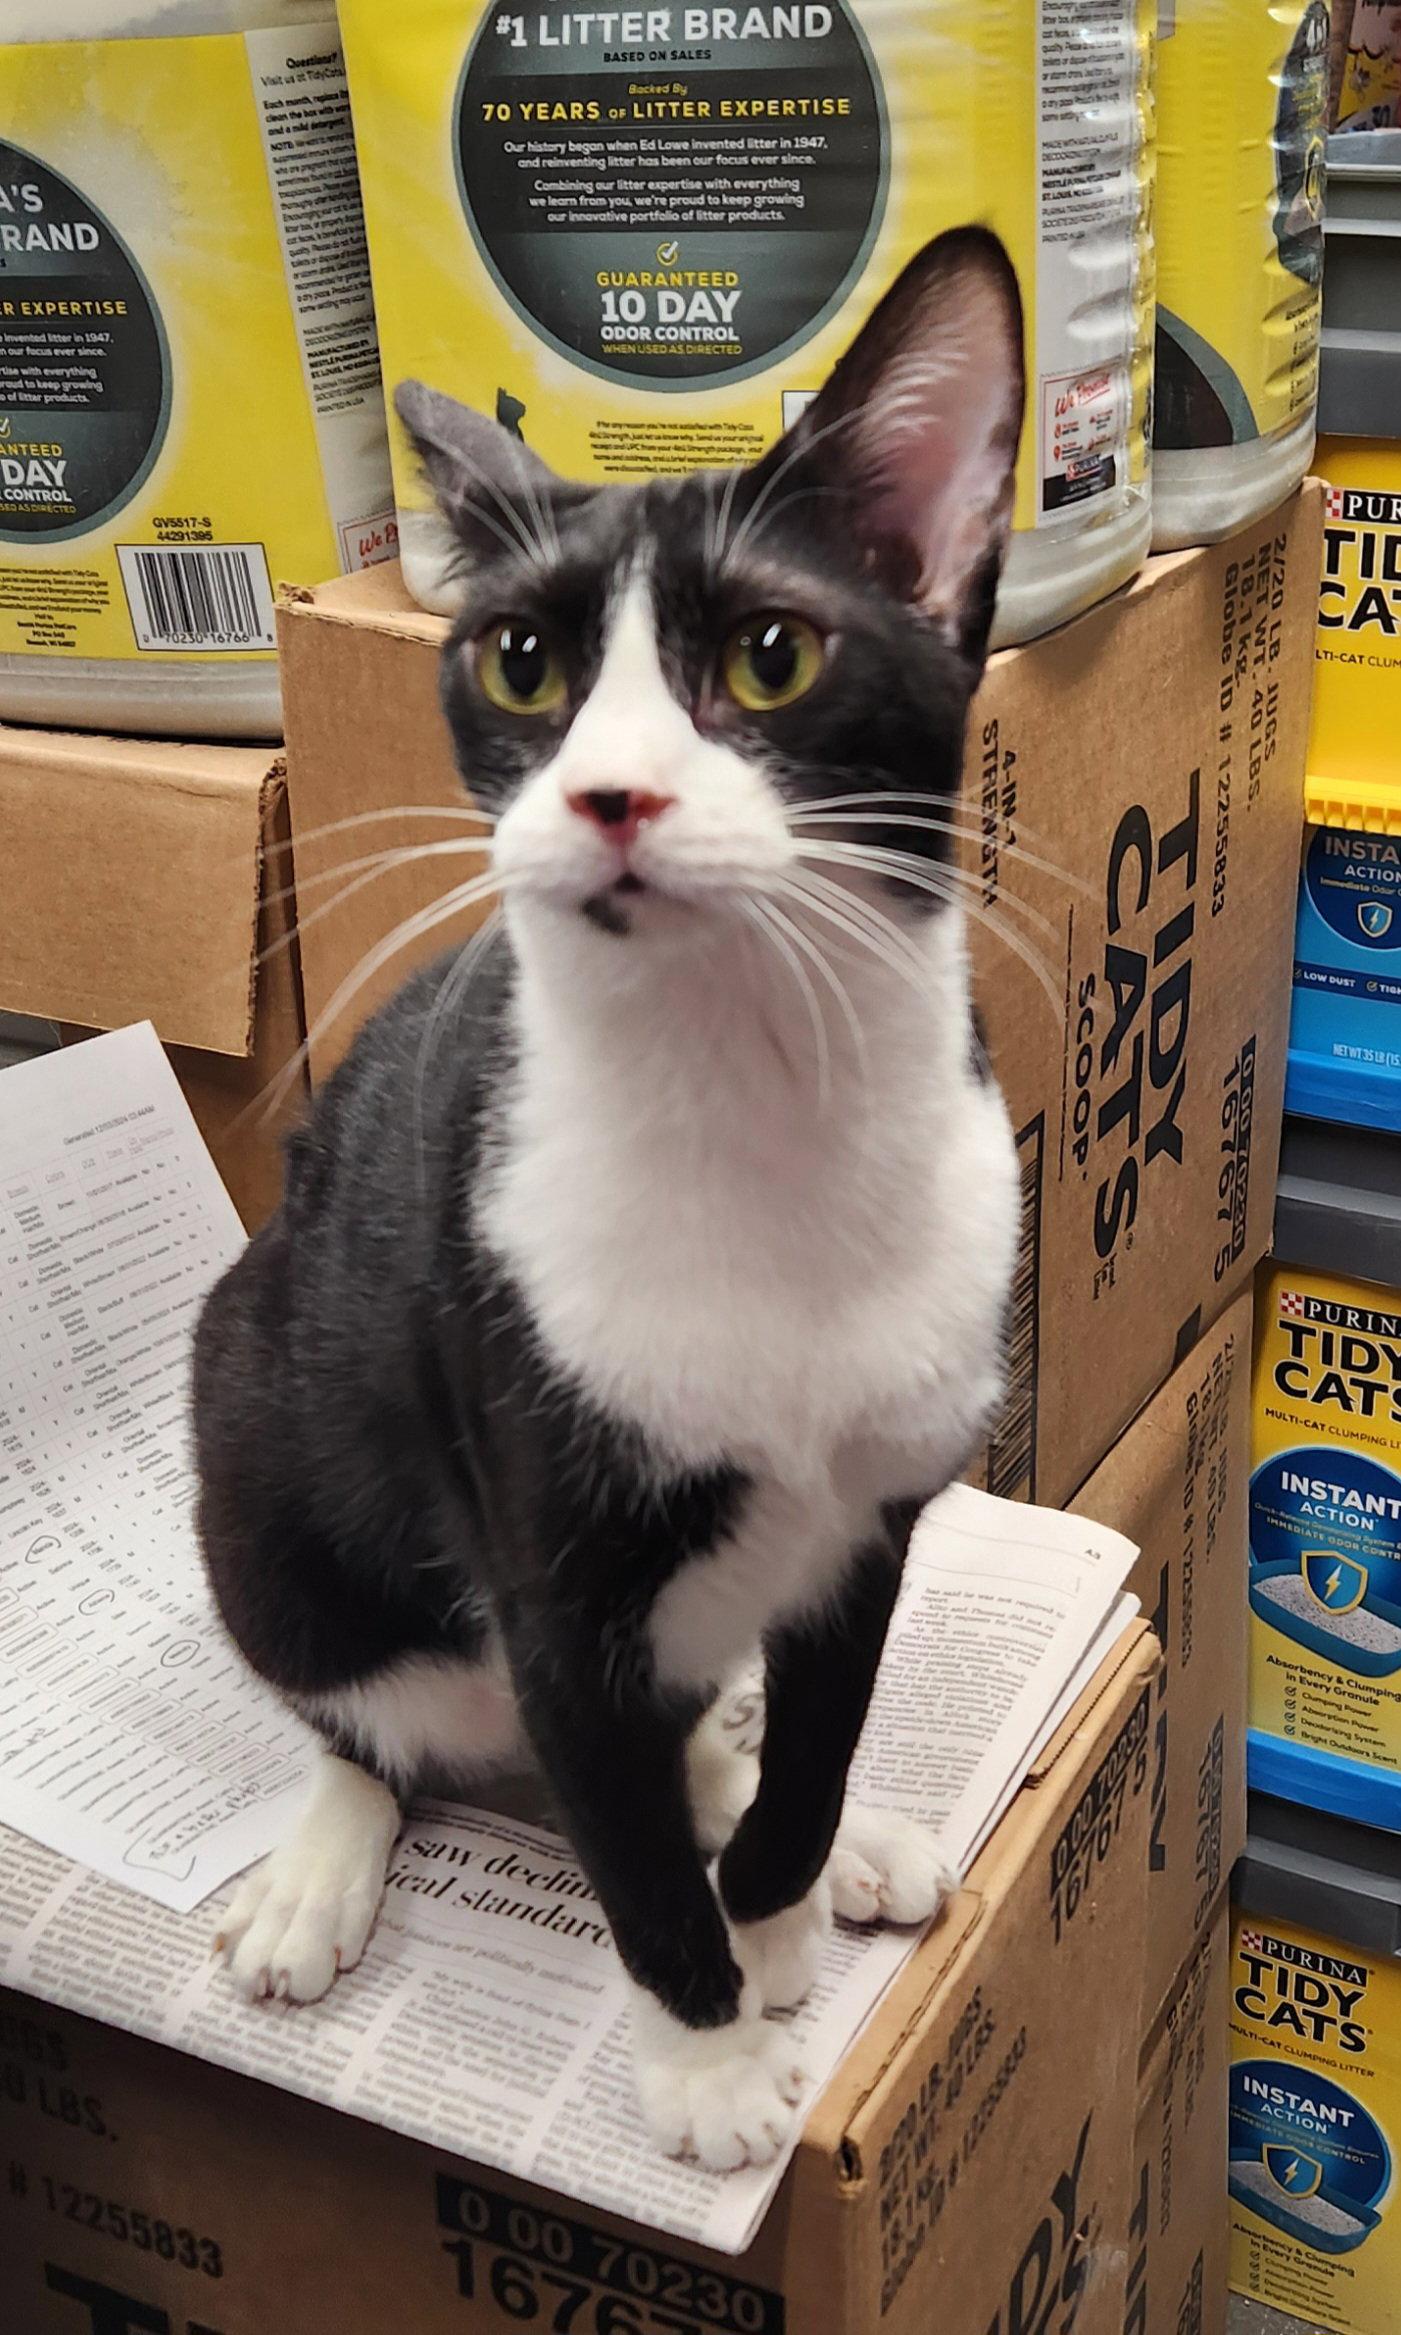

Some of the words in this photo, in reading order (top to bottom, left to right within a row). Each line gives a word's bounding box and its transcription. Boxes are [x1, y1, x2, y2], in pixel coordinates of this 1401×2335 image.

[495, 14, 527, 47] #1
[539, 10, 671, 46] LITTER
[684, 4, 833, 41] BRAND
[603, 51, 645, 62] BASED
[649, 50, 666, 61] ON
[670, 49, 712, 60] SALES
[628, 83, 669, 95] Backed
[672, 82, 688, 96] By
[482, 103, 511, 122] 70
[519, 101, 601, 121] YEARS
[608, 108, 627, 119] OF
[633, 101, 711, 118] LITTER
[720, 98, 851, 117] EXPERTISE
[503, 141, 526, 153] Our
[527, 140, 567, 155] history
[568, 140, 605, 155] began
[606, 139, 638, 151] when
[639, 139, 656, 151] Ed
[657, 139, 690, 150] Lowe
[691, 138, 745, 150] invented
[746, 137, 778, 149] litter
[779, 137, 792, 149] in
[517, 157, 540, 168] and
[541, 157, 607, 171] reinventing
[607, 156, 636, 167] litter
[637, 155, 660, 167] has
[661, 155, 691, 166] been
[692, 156, 714, 166] our
[715, 154, 749, 165] focus
[750, 155, 779, 165] ever
[528, 197, 547, 207] we
[547, 195, 578, 206] learn
[578, 194, 607, 206] from
[633, 194, 668, 205] we're
[668, 194, 705, 208] proud
[707, 194, 721, 205] to
[722, 193, 752, 208] keep
[753, 193, 805, 208] growing
[533, 179, 595, 194] Combining
[595, 181, 615, 190] our
[616, 179, 646, 190] litter
[647, 179, 703, 192] expertise
[704, 178, 732, 189] with
[733, 177, 800, 192] everything
[547, 213, 567, 222] our
[568, 210, 628, 222] innovative
[629, 210, 680, 225] portfolio
[681, 209, 695, 221] of
[696, 209, 726, 221] litter
[727, 209, 786, 223] products.
[596, 271, 739, 287] GUARANTEED
[21, 301, 128, 316] EXPERTISE
[601, 290, 646, 323] 10
[657, 290, 742, 323] DAY
[600, 325, 652, 341] ODOR
[654, 326, 740, 341] CONTROL
[602, 344, 637, 354] WHEN
[638, 344, 667, 354] USED
[668, 344, 684, 354] AS
[685, 344, 743, 355] DIRECTED
[0, 459, 67, 487] DAY
[3, 488, 73, 502] CONTROL
[18, 504, 31, 512] AS
[31, 504, 77, 514] DIRECTED
[157, 530, 213, 541] 44291395
[1256, 542, 1272, 605] NET
[1270, 533, 1287, 603] 2/20
[1238, 553, 1255, 625] 18.1
[1220, 561, 1239, 665] Globe
[1318, 581, 1401, 634] CA
[165, 633, 204, 644] 70230
[210, 633, 250, 644] 16766
[1252, 615, 1268, 680] WT.
[1219, 674, 1234, 714] ID
[1250, 689, 1264, 729] 40
[1218, 722, 1233, 743] #
[1263, 680, 1280, 762] JUGS
[1246, 740, 1262, 813] LBS.
[1211, 756, 1231, 919] 12255833
[1325, 836, 1401, 865] INSTA
[1144, 767, 1200, 1167] TIDY
[1303, 970, 1328, 983] LOW
[1329, 975, 1356, 988] DUST
[1094, 804, 1153, 1258] CATS
[1242, 1053, 1254, 1077] 0
[1332, 1043, 1349, 1058] NET
[1072, 972, 1096, 1167] SCOOP
[1239, 1086, 1252, 1132] 00
[1217, 1054, 1240, 1221] 16767
[1232, 1139, 1251, 1249] 70230
[1213, 1243, 1231, 1283] 5
[1308, 1300, 1401, 1336] PURIN
[1279, 1319, 1401, 1381] TIDY
[1265, 1407, 1327, 1432] MULTI-CAT
[1328, 1425, 1387, 1447] CLUMPING
[1281, 1470, 1401, 1519] INSTANT
[1300, 1501, 1374, 1531] ACTION
[1267, 1516, 1324, 1541] IMMEDIATE
[1327, 1535, 1360, 1551] ODOR
[1266, 1654, 1334, 1683] Absorbency
[1336, 1676, 1344, 1685] &
[1346, 1679, 1401, 1703] Clumping
[1298, 1676, 1332, 1693] Every
[1333, 1686, 1380, 1706] Granule
[1302, 1692, 1342, 1711] Clumping
[1344, 1704, 1372, 1717] Power
[1351, 1719, 1379, 1732] Power
[1354, 1733, 1387, 1747] System
[1301, 1731, 1328, 1745] Bright
[1372, 1752, 1398, 1765] Scent
[404, 1837, 483, 1868] saw
[384, 1864, 458, 1899] ical
[1267, 1939, 1363, 1984] PURINA
[1239, 1952, 1365, 2019] TIDY
[1235, 1987, 1366, 2053] CATS
[1228, 2022, 1281, 2049] MULTI-CAT
[1284, 2044, 1337, 2068] CLUMPING
[1339, 2061, 1375, 2077] LITTER
[1243, 2075, 1354, 2128] INSTANT
[1260, 2103, 1327, 2135] ACTION
[1316, 2145, 1366, 2165] CONTROL
[459, 2191, 490, 2232] 0
[508, 2209, 574, 2263] 00
[592, 2237, 765, 2331] 70230
